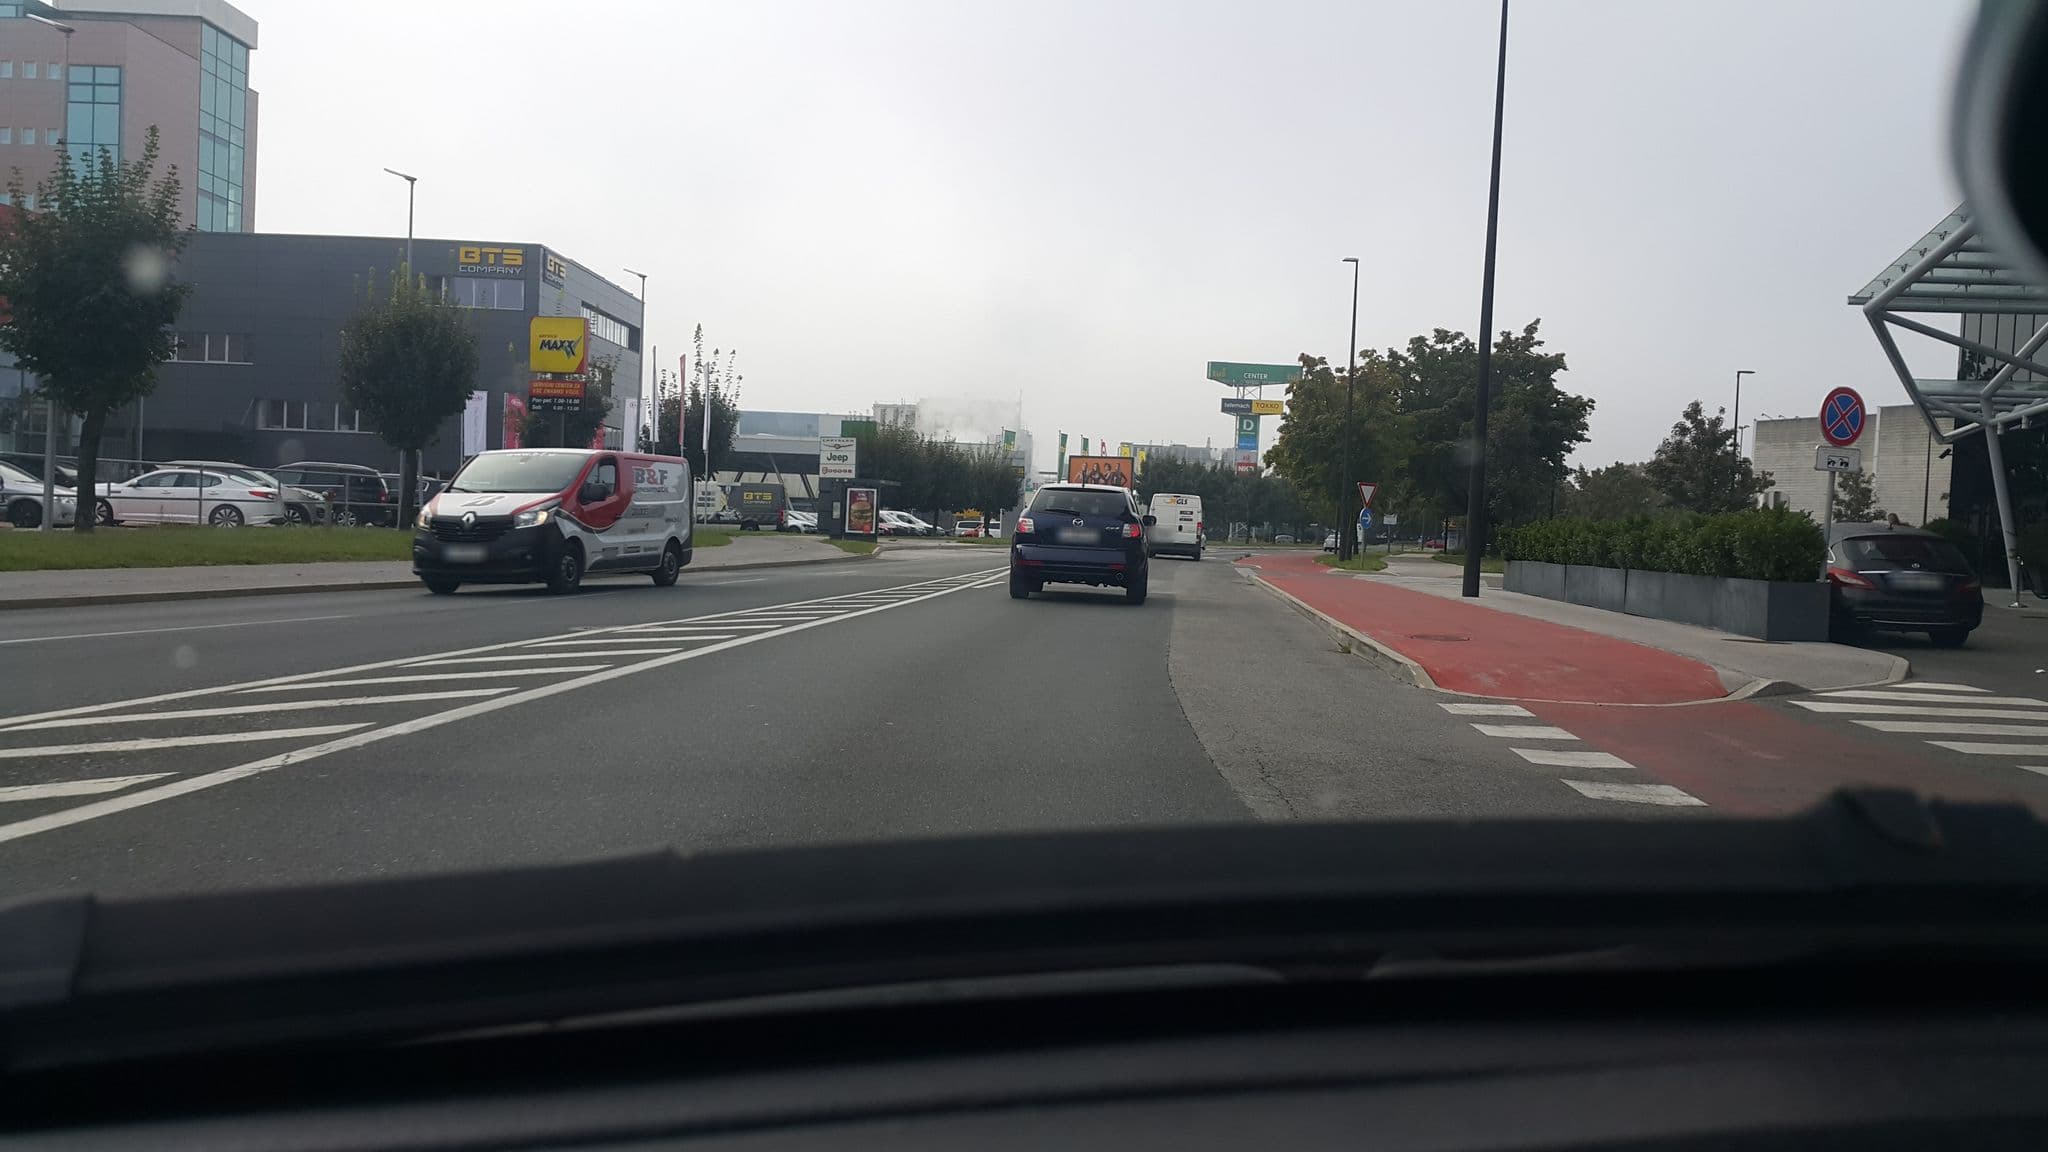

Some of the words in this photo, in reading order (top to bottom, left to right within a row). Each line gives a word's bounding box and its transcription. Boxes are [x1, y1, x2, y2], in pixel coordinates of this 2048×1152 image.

[459, 265, 522, 274] COMPANY
[1243, 419, 1255, 431] D
[826, 452, 849, 462] Jeep
[632, 468, 669, 485] B&F
